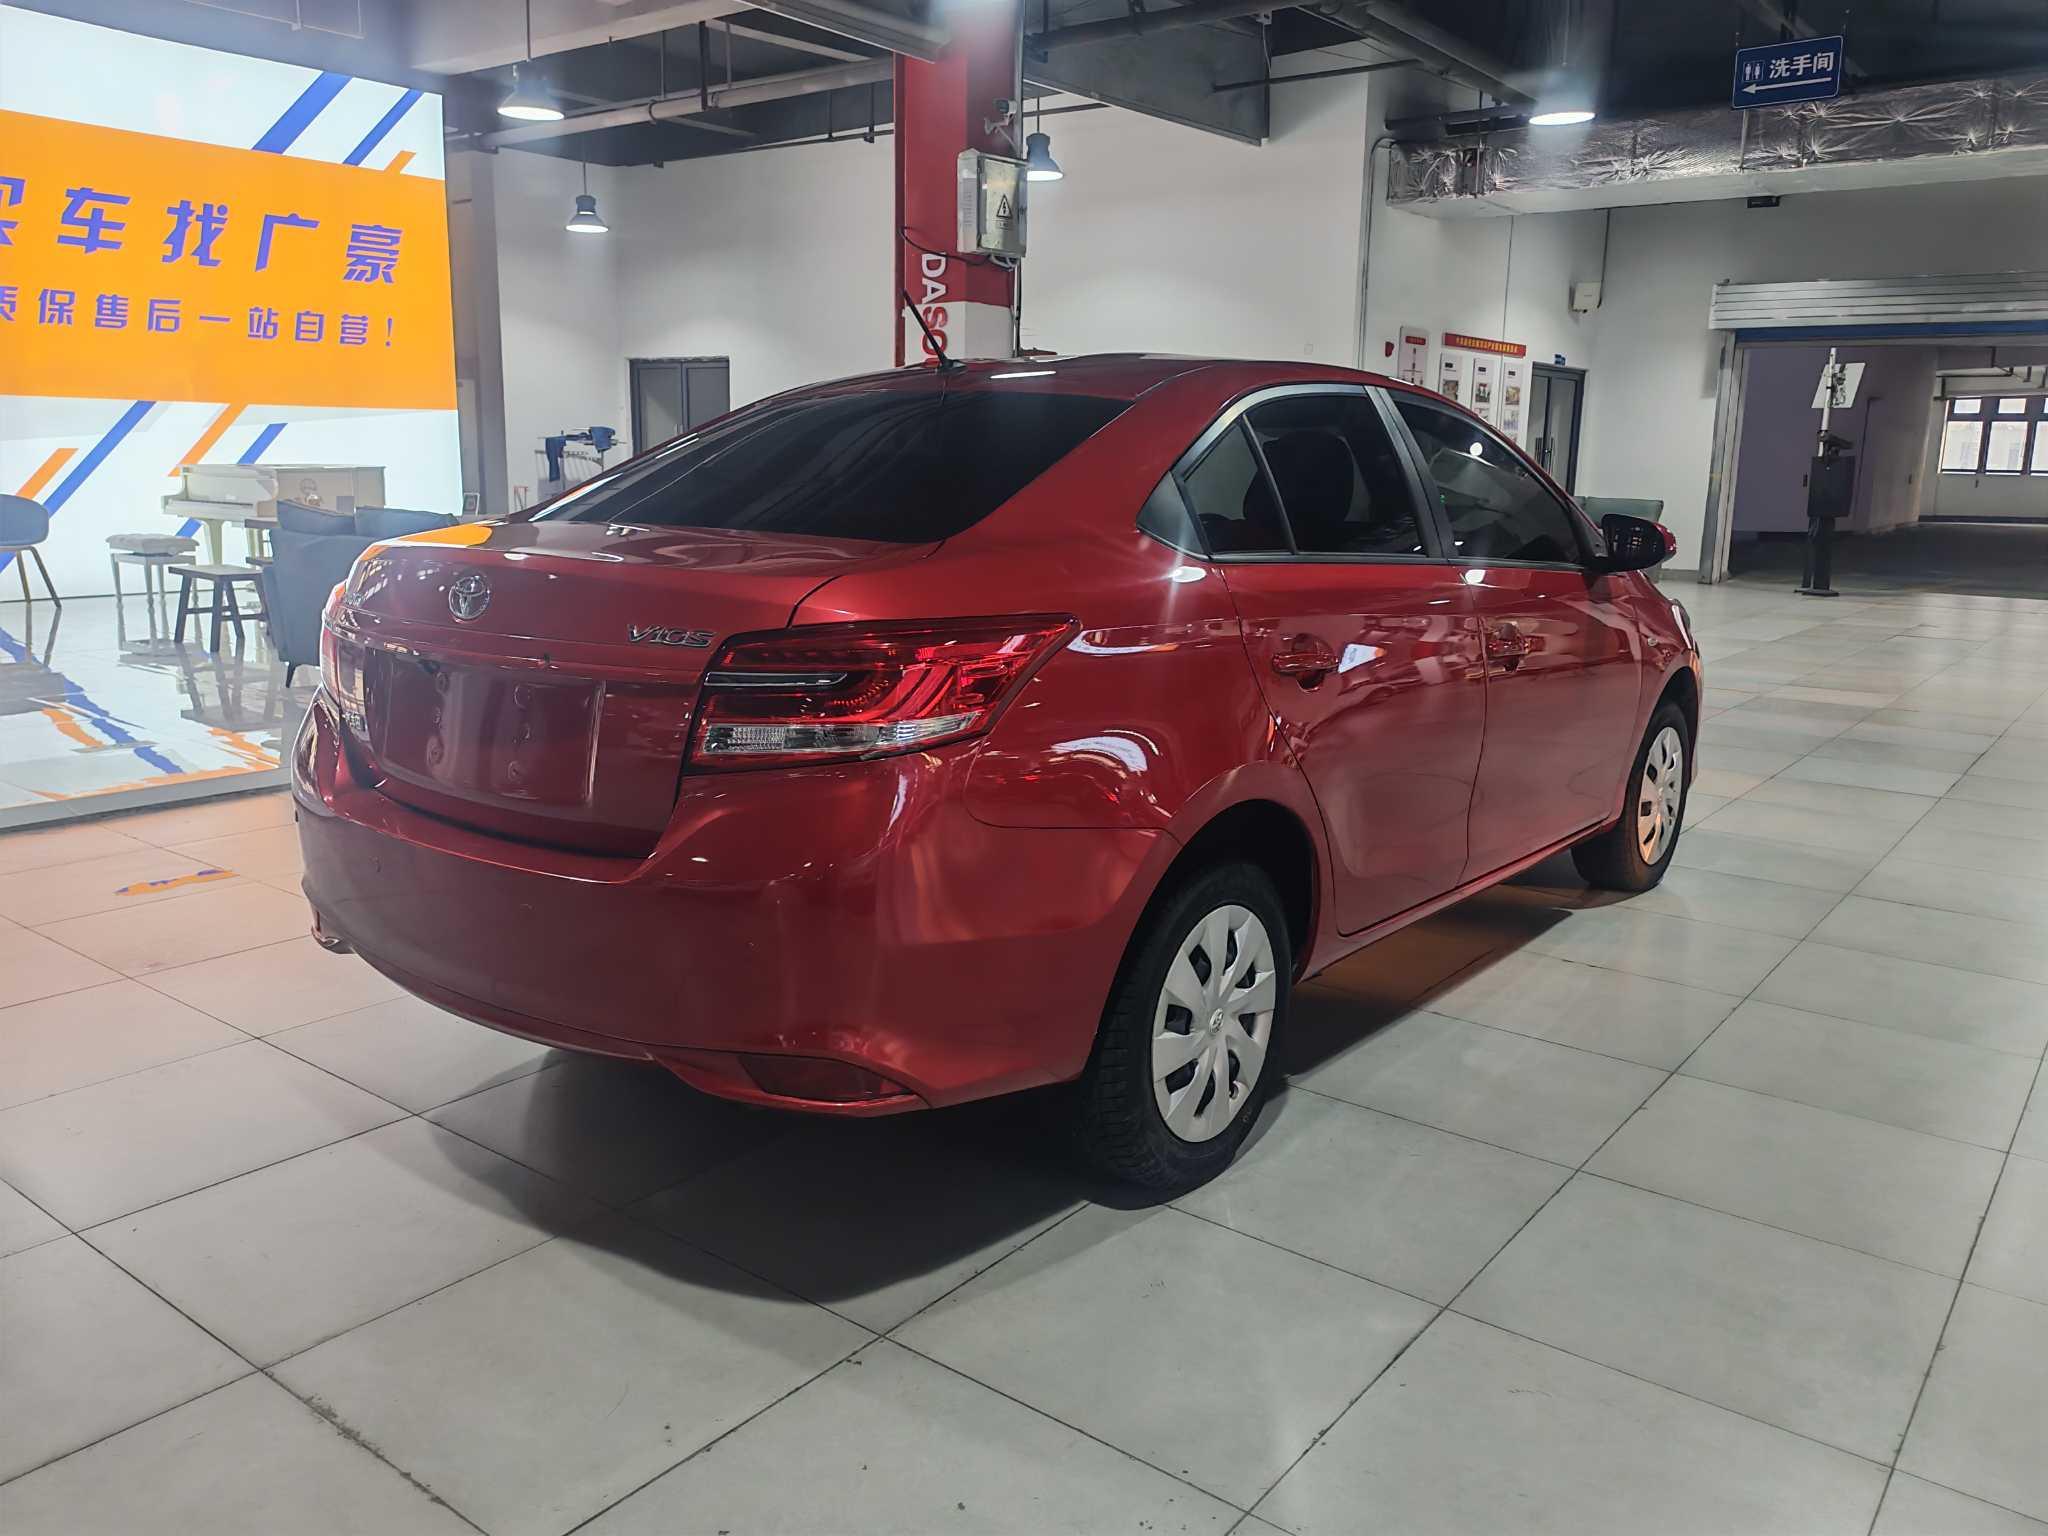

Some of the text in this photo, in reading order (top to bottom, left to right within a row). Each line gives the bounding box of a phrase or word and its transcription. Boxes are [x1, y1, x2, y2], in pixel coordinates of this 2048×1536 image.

[1769, 51, 1834, 79] 洗手间
[921, 251, 948, 368] DASO
[626, 624, 717, 648] VIOS
